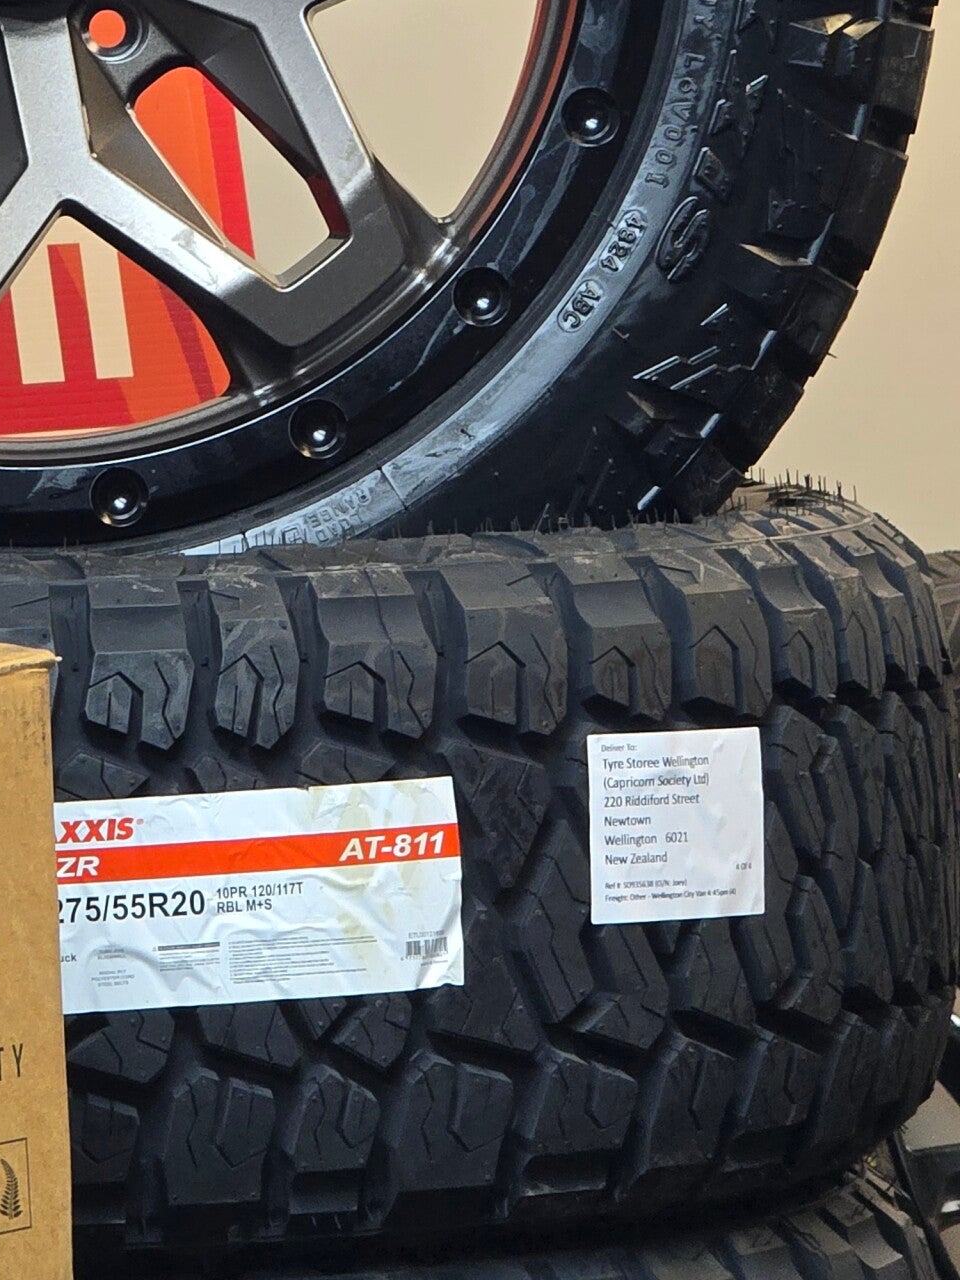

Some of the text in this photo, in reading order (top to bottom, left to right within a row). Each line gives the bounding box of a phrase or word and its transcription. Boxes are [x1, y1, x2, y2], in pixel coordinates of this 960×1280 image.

[562, 281, 601, 329] ABC
[602, 755, 710, 772] Tyre Storee Wellington
[657, 774, 692, 787] Society
[693, 772, 710, 787] Ltd)
[604, 793, 700, 808] 220 Riddiford Street
[604, 816, 652, 827] Newtown
[338, 830, 445, 862] AT-811
[604, 831, 689, 848] Wellington 6021
[605, 851, 668, 865] New Zealand
[216, 885, 248, 900] 10PR
[252, 881, 304, 898] 120/117T
[216, 898, 273, 914] RBL M+S
